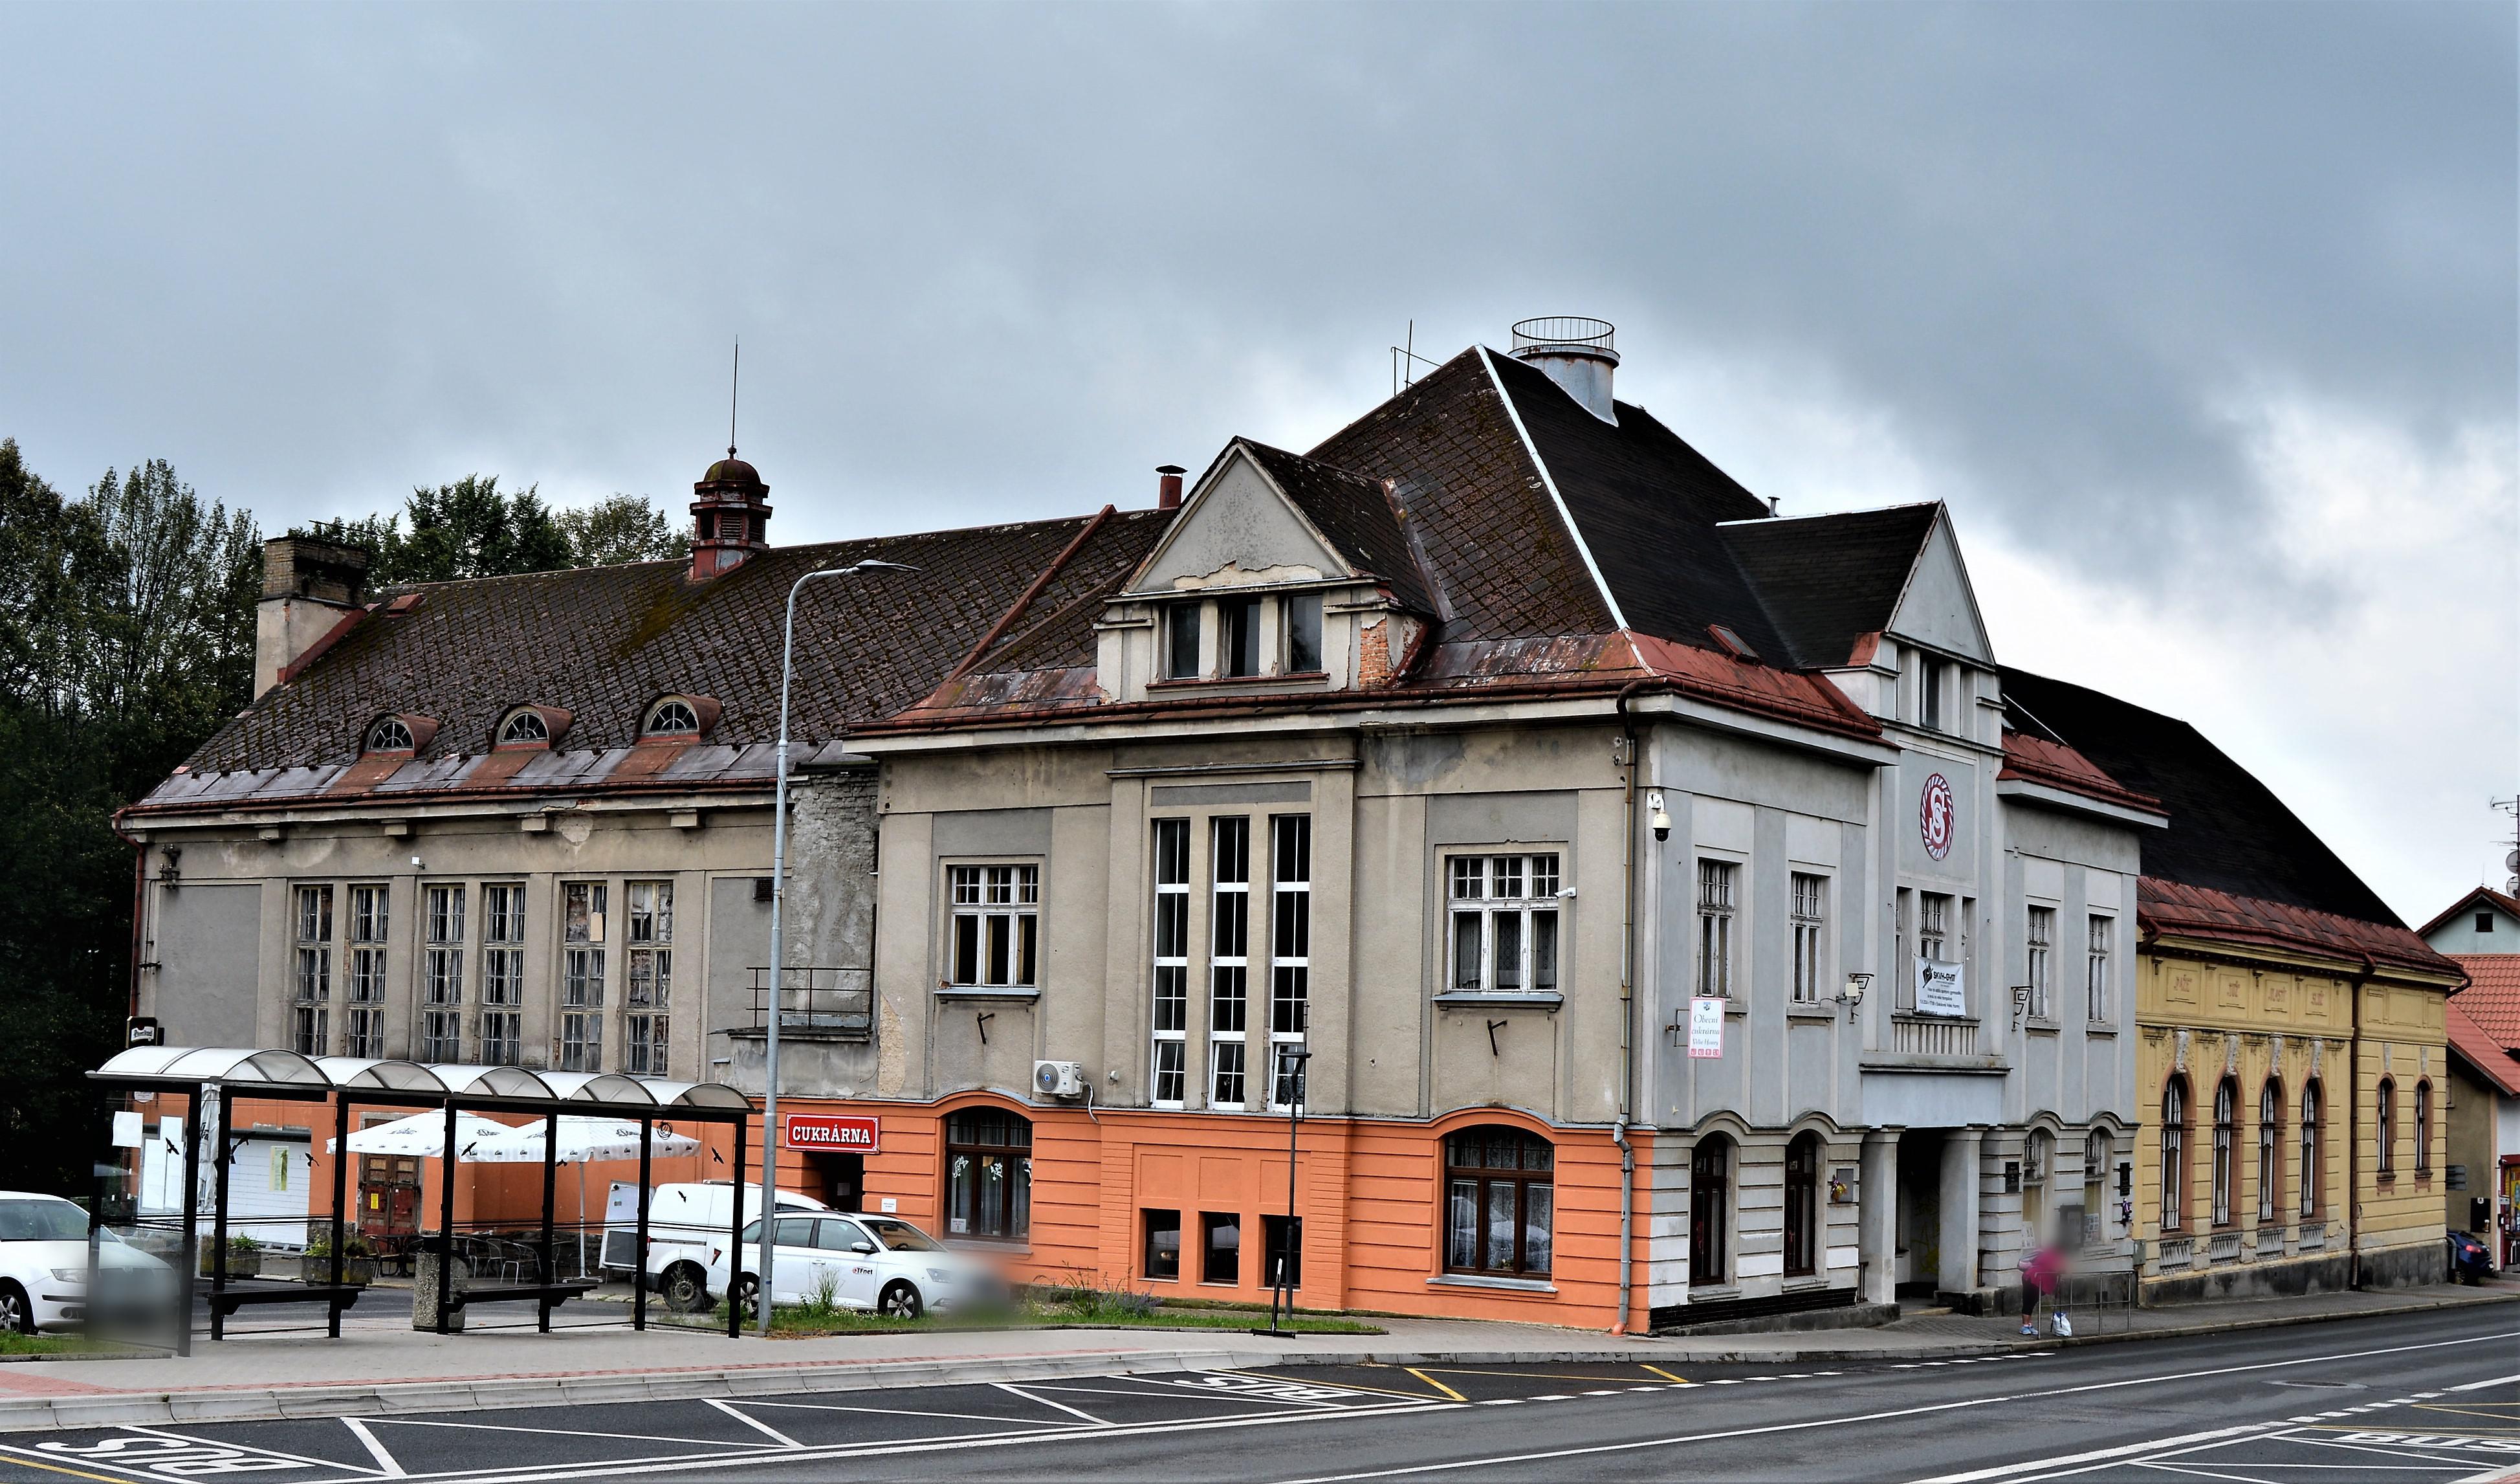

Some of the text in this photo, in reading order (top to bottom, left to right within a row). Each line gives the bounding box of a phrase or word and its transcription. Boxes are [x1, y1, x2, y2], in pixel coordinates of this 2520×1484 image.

[1691, 1026, 1720, 1035] cukrárna
[792, 1124, 871, 1144] CUKRÁRNA
[1173, 1377, 1364, 1400] BUS
[2332, 1432, 2520, 1451] BUS
[35, 1437, 316, 1476] BUS
